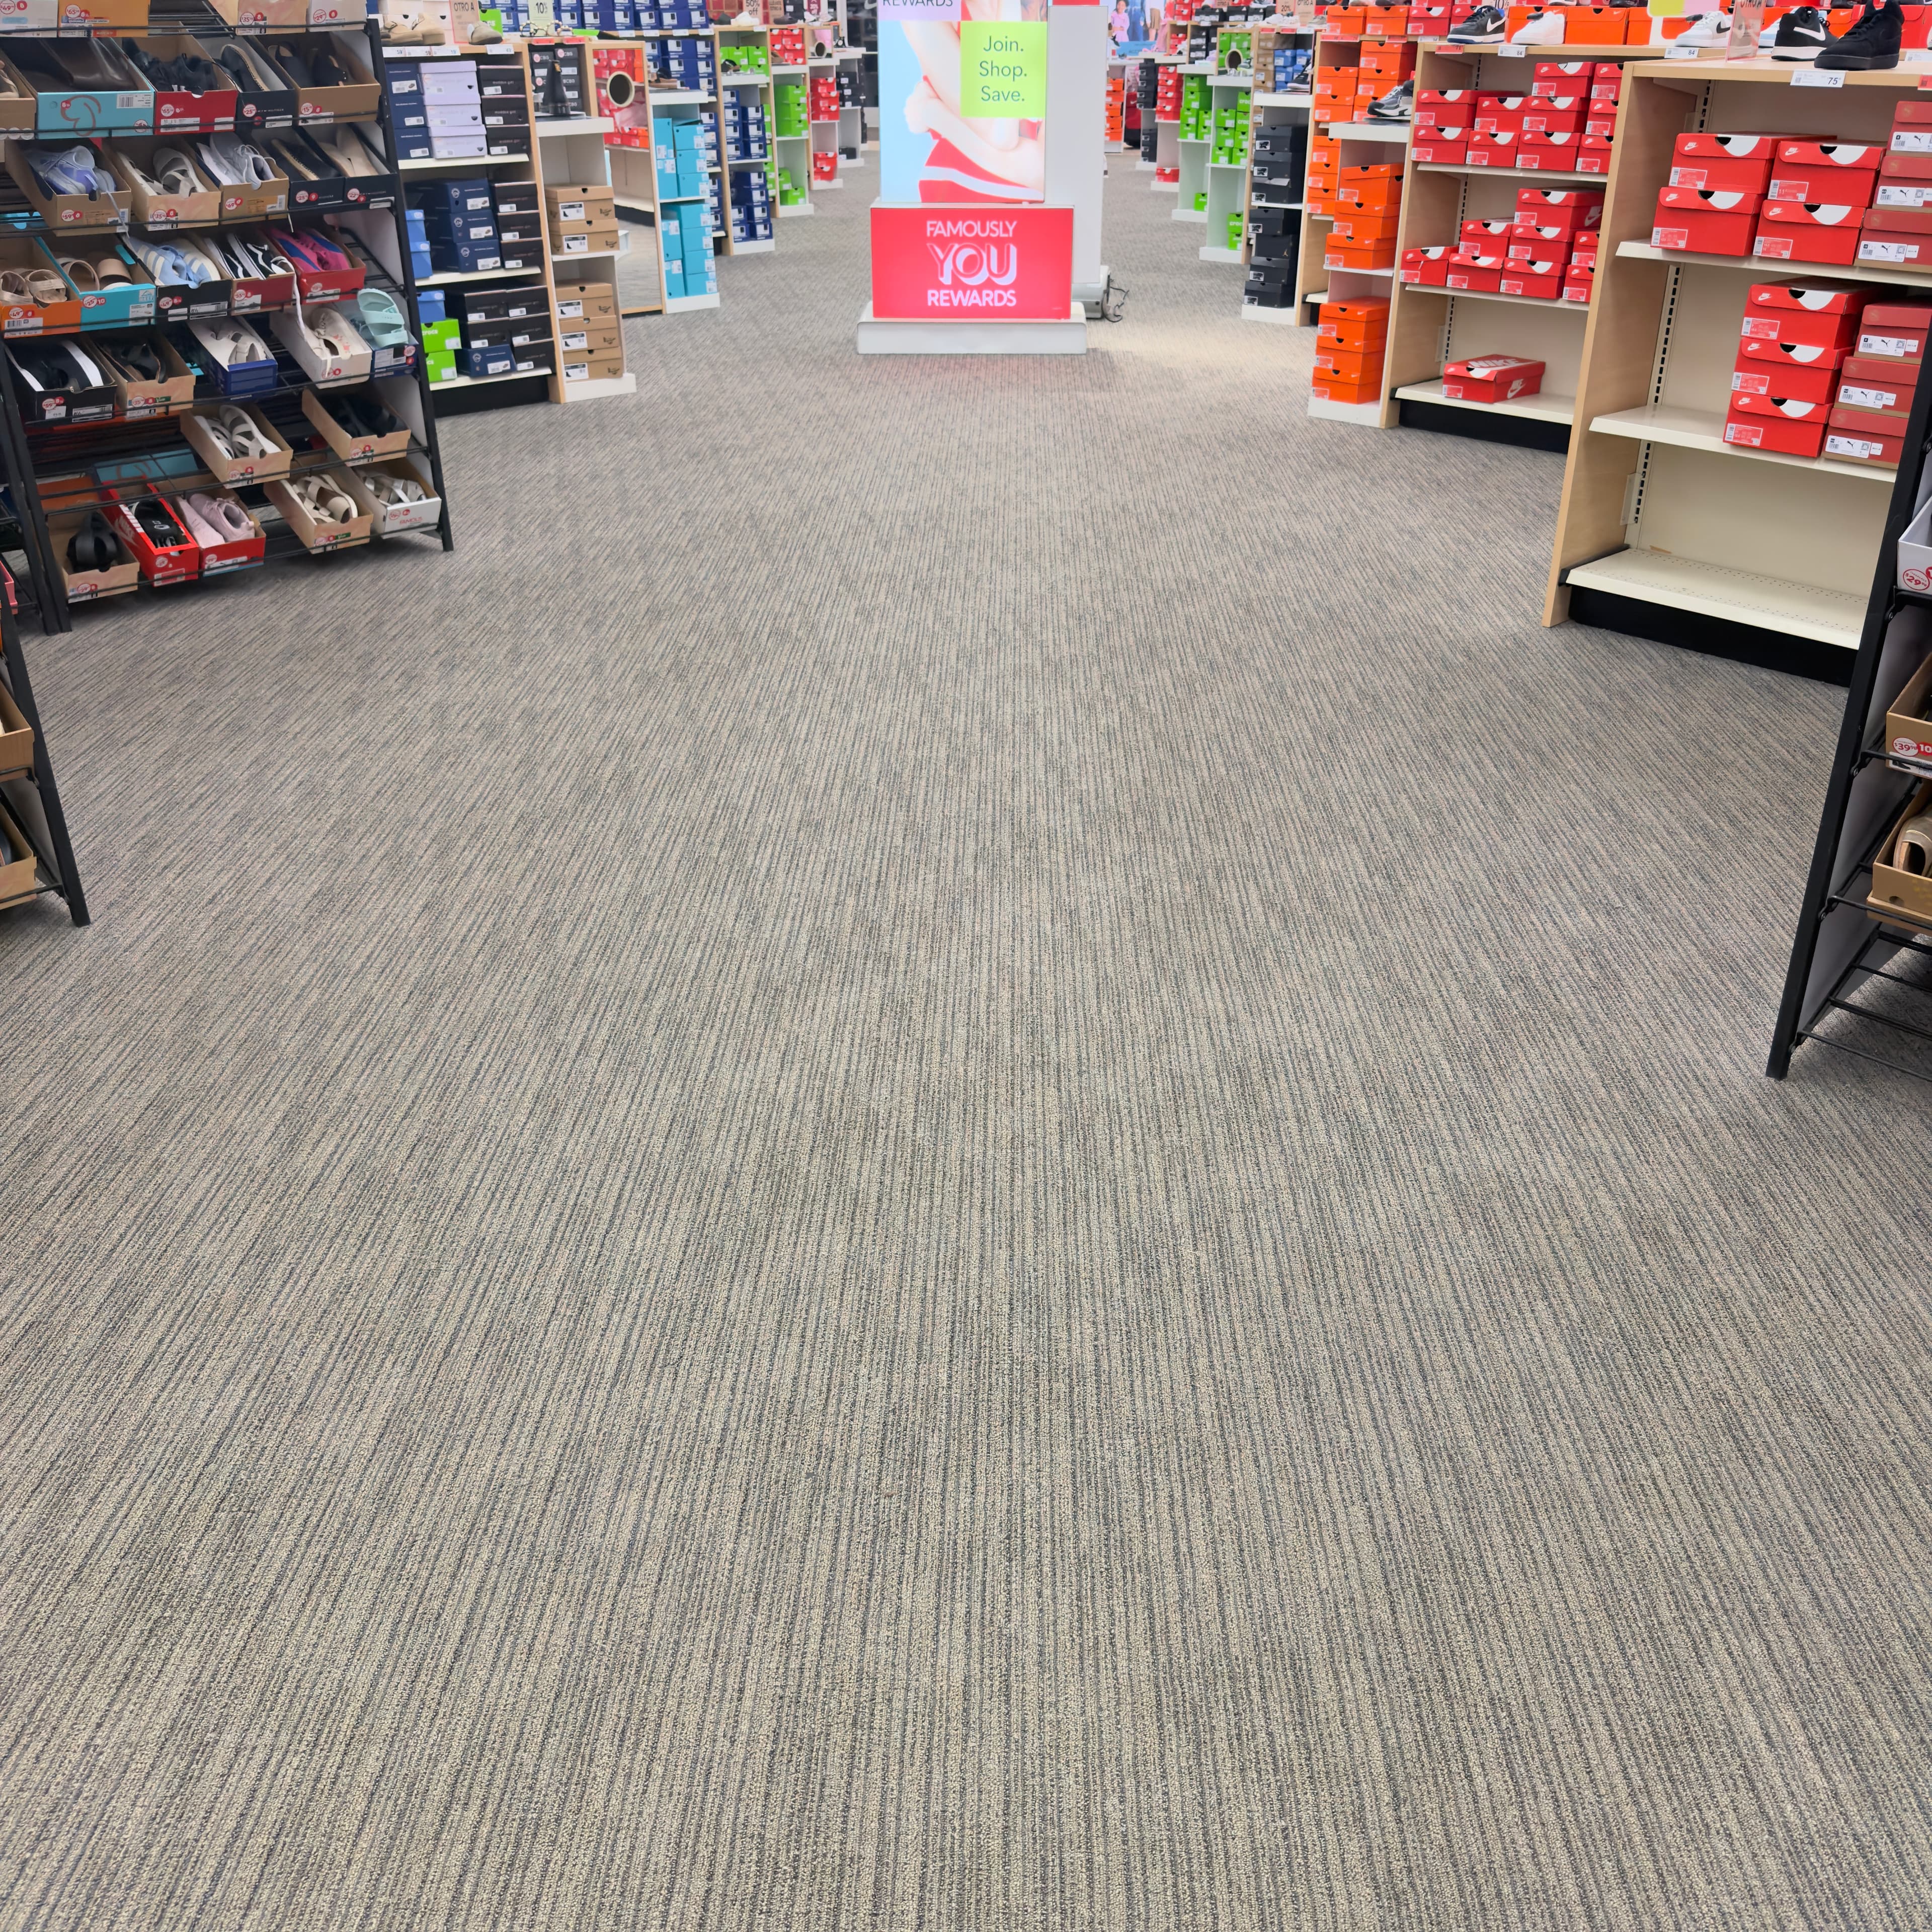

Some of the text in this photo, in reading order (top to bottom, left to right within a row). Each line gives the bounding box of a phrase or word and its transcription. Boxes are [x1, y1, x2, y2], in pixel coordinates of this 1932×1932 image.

[454, 2, 475, 12] OTRO A
[984, 36, 1024, 52] Join.
[979, 61, 1027, 81] Shop.
[981, 86, 1025, 102] Save.
[926, 220, 1017, 237] FAMOUSLY
[927, 242, 1017, 286] YOU
[927, 289, 1016, 306] REWARDS
[1468, 359, 1519, 368] NIKE
[1919, 744, 1932, 754] 10
